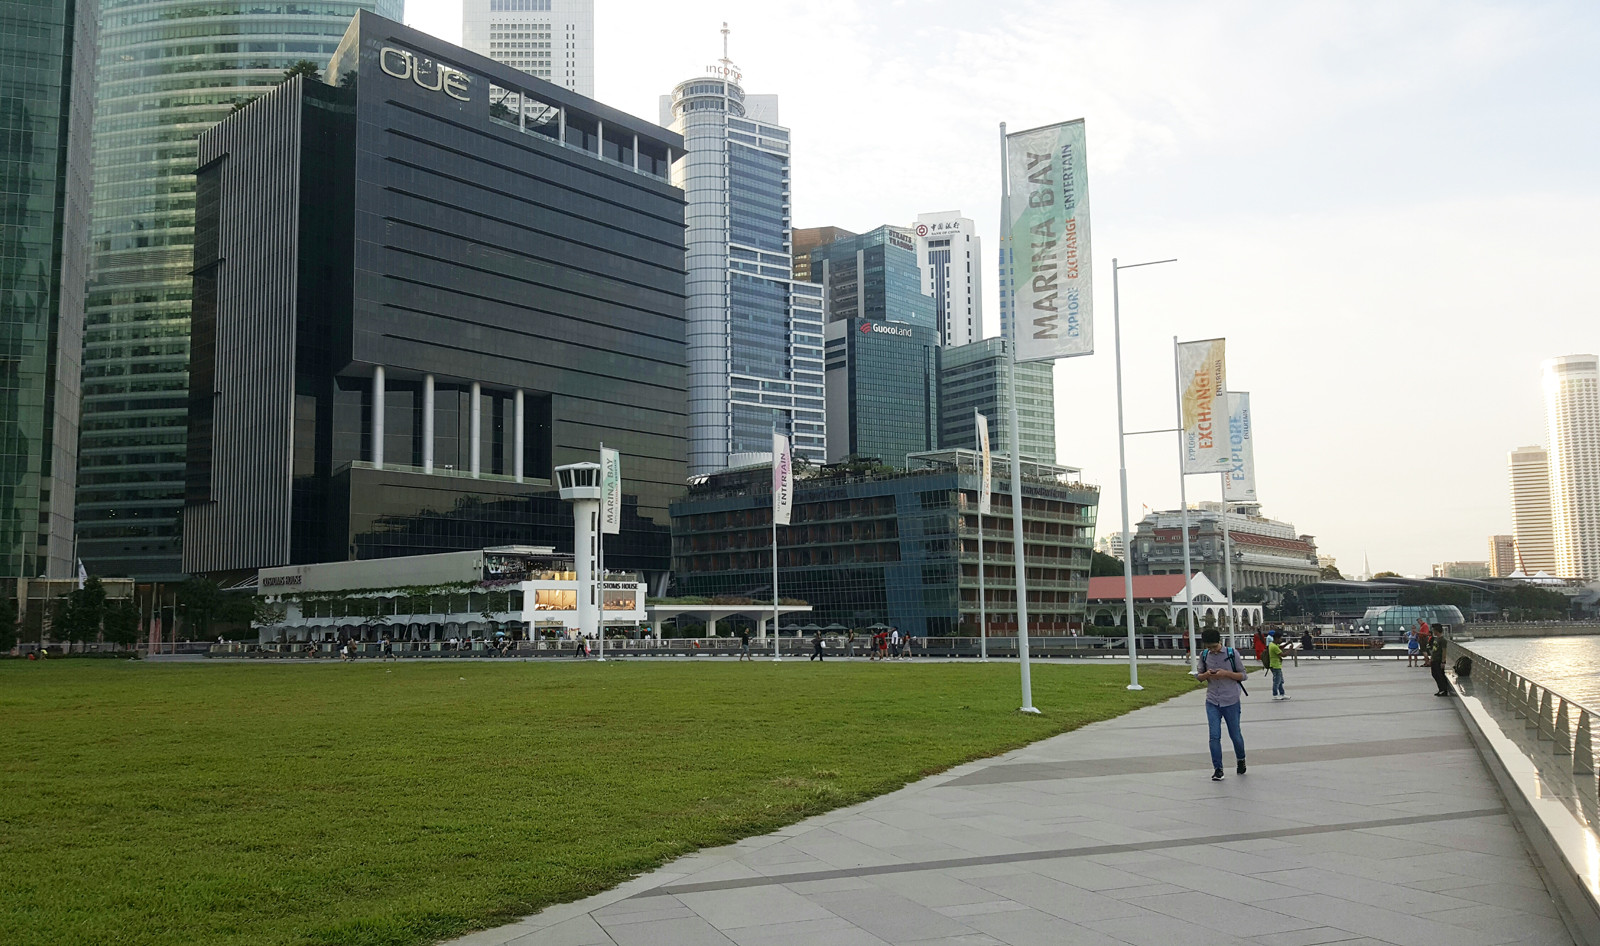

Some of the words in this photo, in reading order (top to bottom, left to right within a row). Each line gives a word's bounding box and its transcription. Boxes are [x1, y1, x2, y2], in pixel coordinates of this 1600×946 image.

[380, 47, 470, 102] OUE
[1026, 151, 1055, 208] BAY
[1062, 144, 1075, 210] ENTERTAIN
[1031, 217, 1058, 339] MARINA
[1065, 217, 1078, 279] EXCHANGE
[1067, 287, 1078, 338] EXPLORE
[1195, 370, 1213, 449] EXCHANGE
[1230, 416, 1244, 481] EXPLORE
